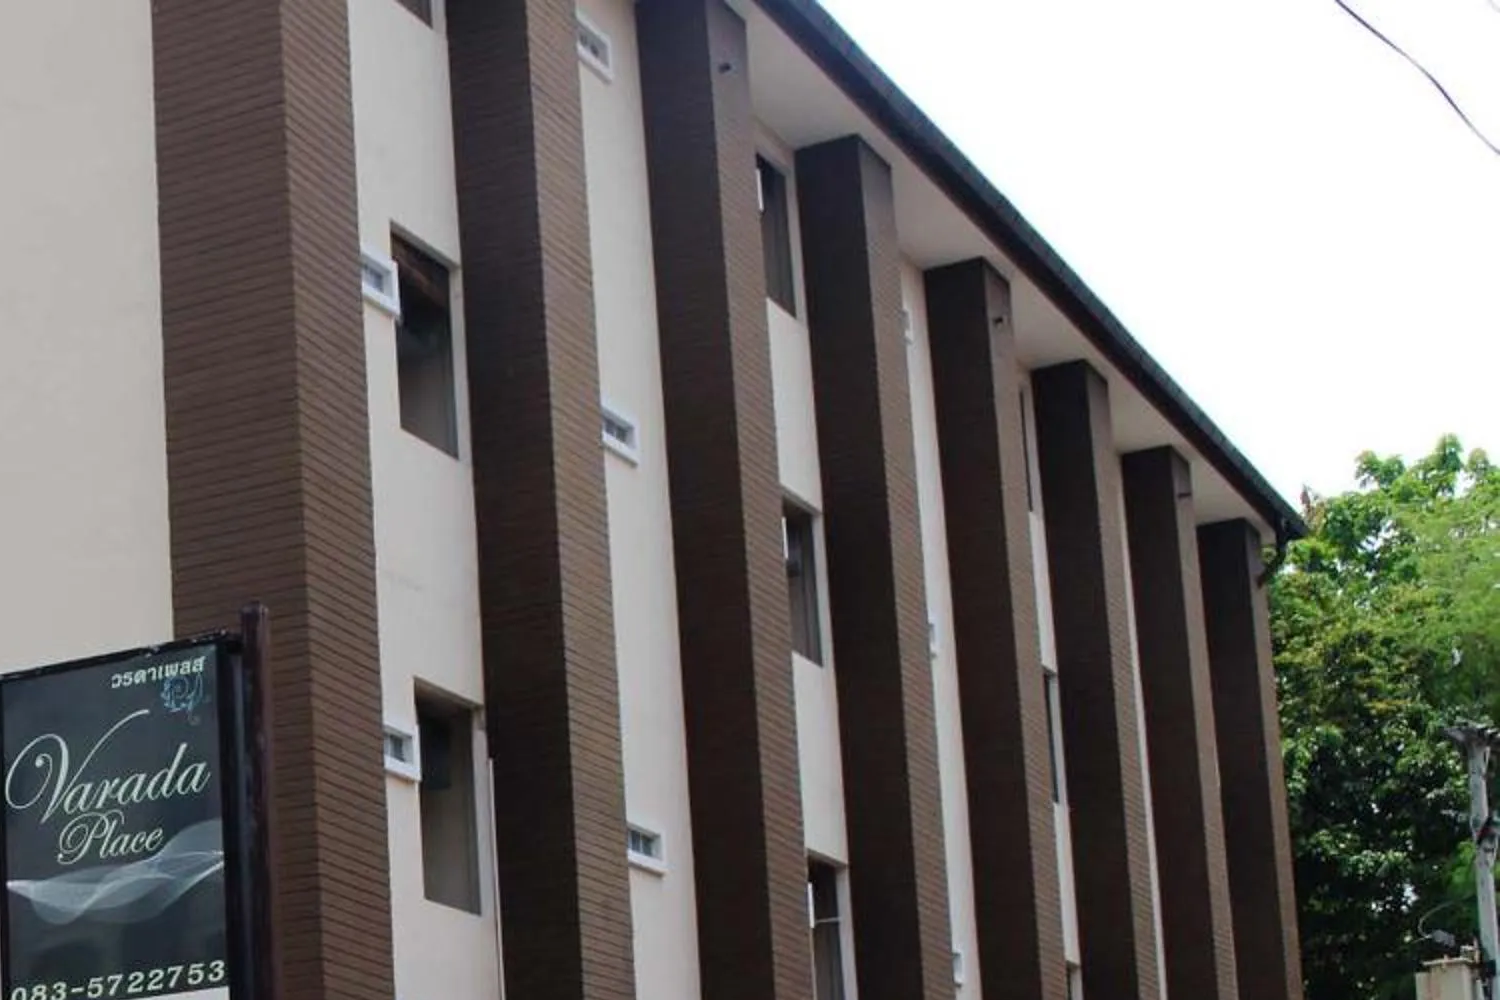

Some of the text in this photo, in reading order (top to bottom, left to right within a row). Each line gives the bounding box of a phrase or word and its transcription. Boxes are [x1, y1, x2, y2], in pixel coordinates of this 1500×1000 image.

[111, 656, 206, 689] วรดาเพลส
[5, 709, 211, 825] Varada
[57, 809, 164, 865] Place
